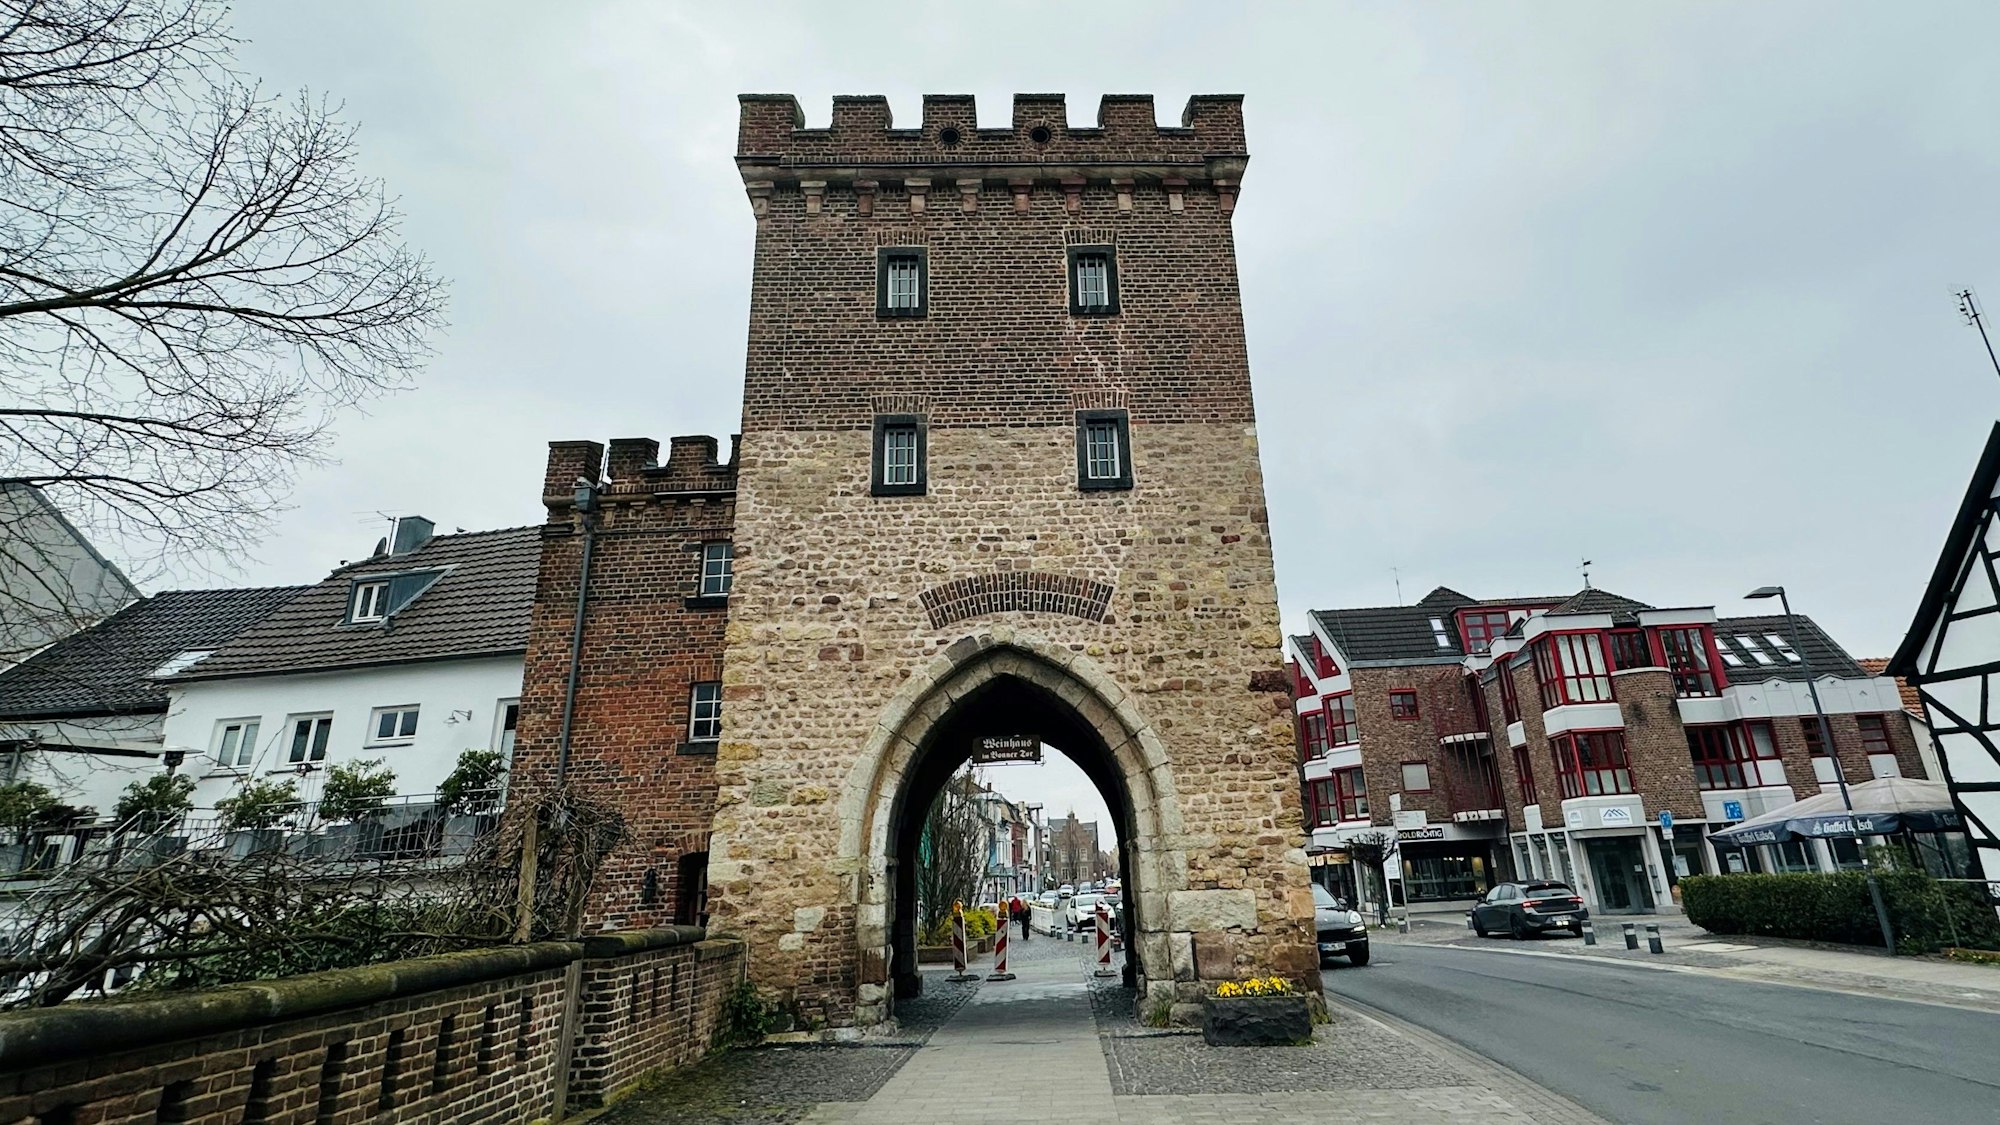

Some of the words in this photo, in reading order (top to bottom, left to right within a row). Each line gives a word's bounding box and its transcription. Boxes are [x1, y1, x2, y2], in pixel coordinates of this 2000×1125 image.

[982, 738, 1032, 749] Weinhaus
[990, 750, 1017, 759] Bonner
[1019, 749, 1033, 757] Tor
[1823, 820, 1847, 833] Gaffel
[1847, 818, 1874, 833] Klsch
